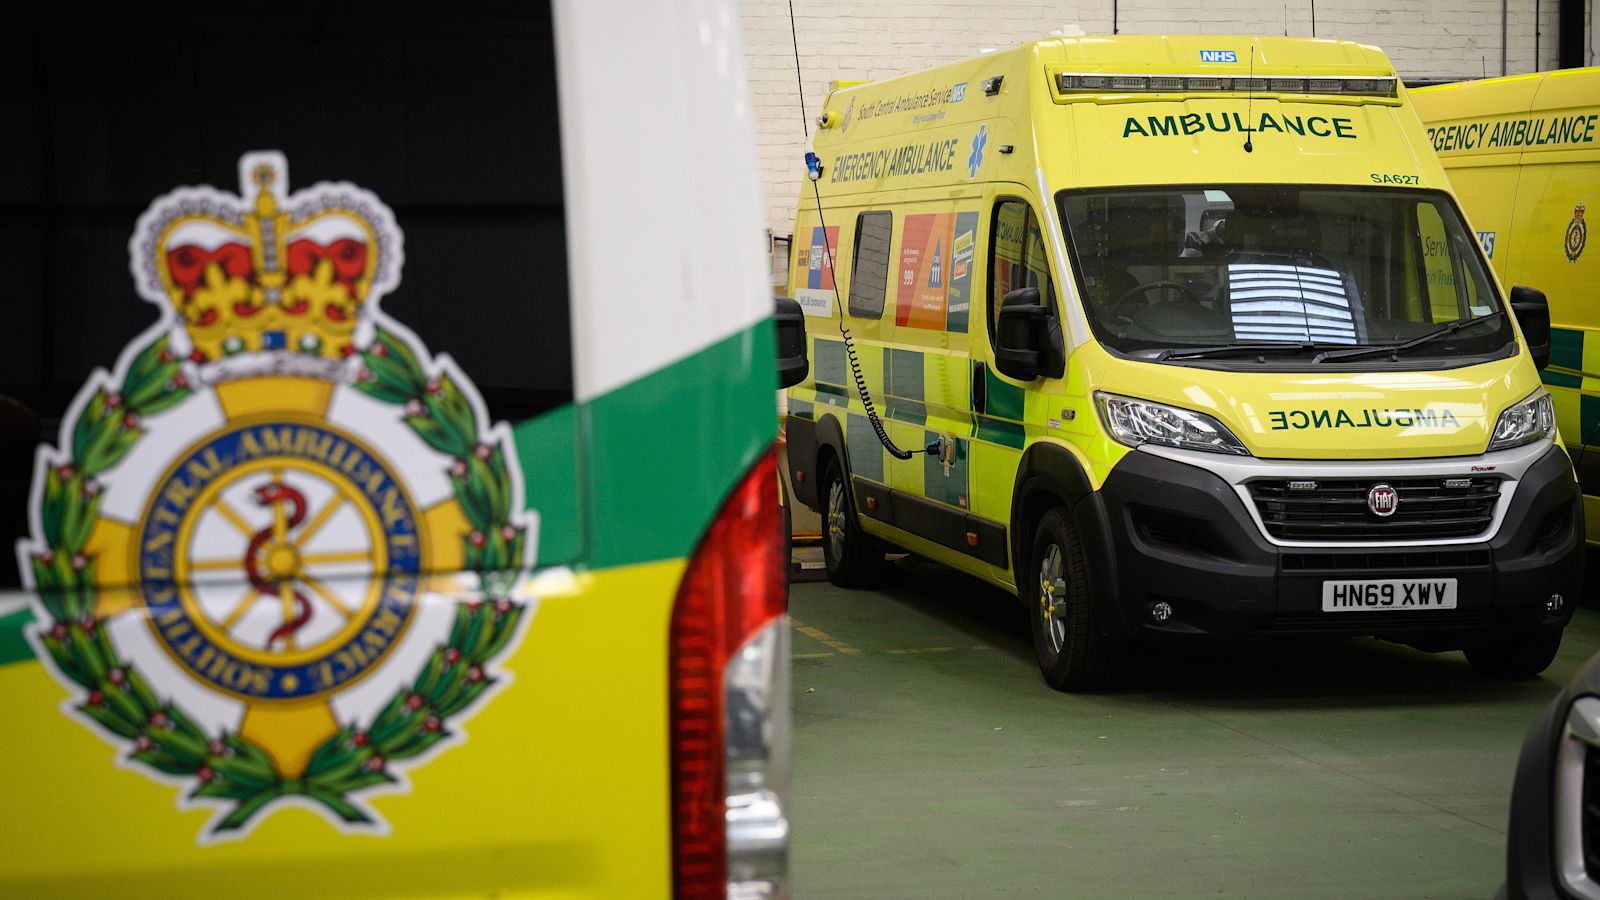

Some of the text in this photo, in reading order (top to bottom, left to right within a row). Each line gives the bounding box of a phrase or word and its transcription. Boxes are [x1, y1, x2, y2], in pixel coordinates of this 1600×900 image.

[1201, 50, 1236, 62] NHS
[857, 101, 876, 121] South
[874, 97, 897, 118] Central
[893, 91, 930, 112] Ambulance
[927, 86, 952, 107] Service
[1122, 112, 1357, 139] AMBULANCE
[1427, 115, 1599, 153] RGENCY AMBULANCE
[831, 138, 958, 184] EMERGENCY AMBULANCE
[1370, 173, 1420, 186] SA627
[1424, 236, 1450, 257] Servi
[903, 269, 914, 286] 999
[931, 265, 941, 283] 111
[236, 426, 417, 550] AMBULANCE
[1374, 491, 1394, 509] FIAT
[145, 447, 231, 606] CENTRAL
[1333, 582, 1447, 608] HN69 XWV
[156, 606, 272, 693] SOUTH
